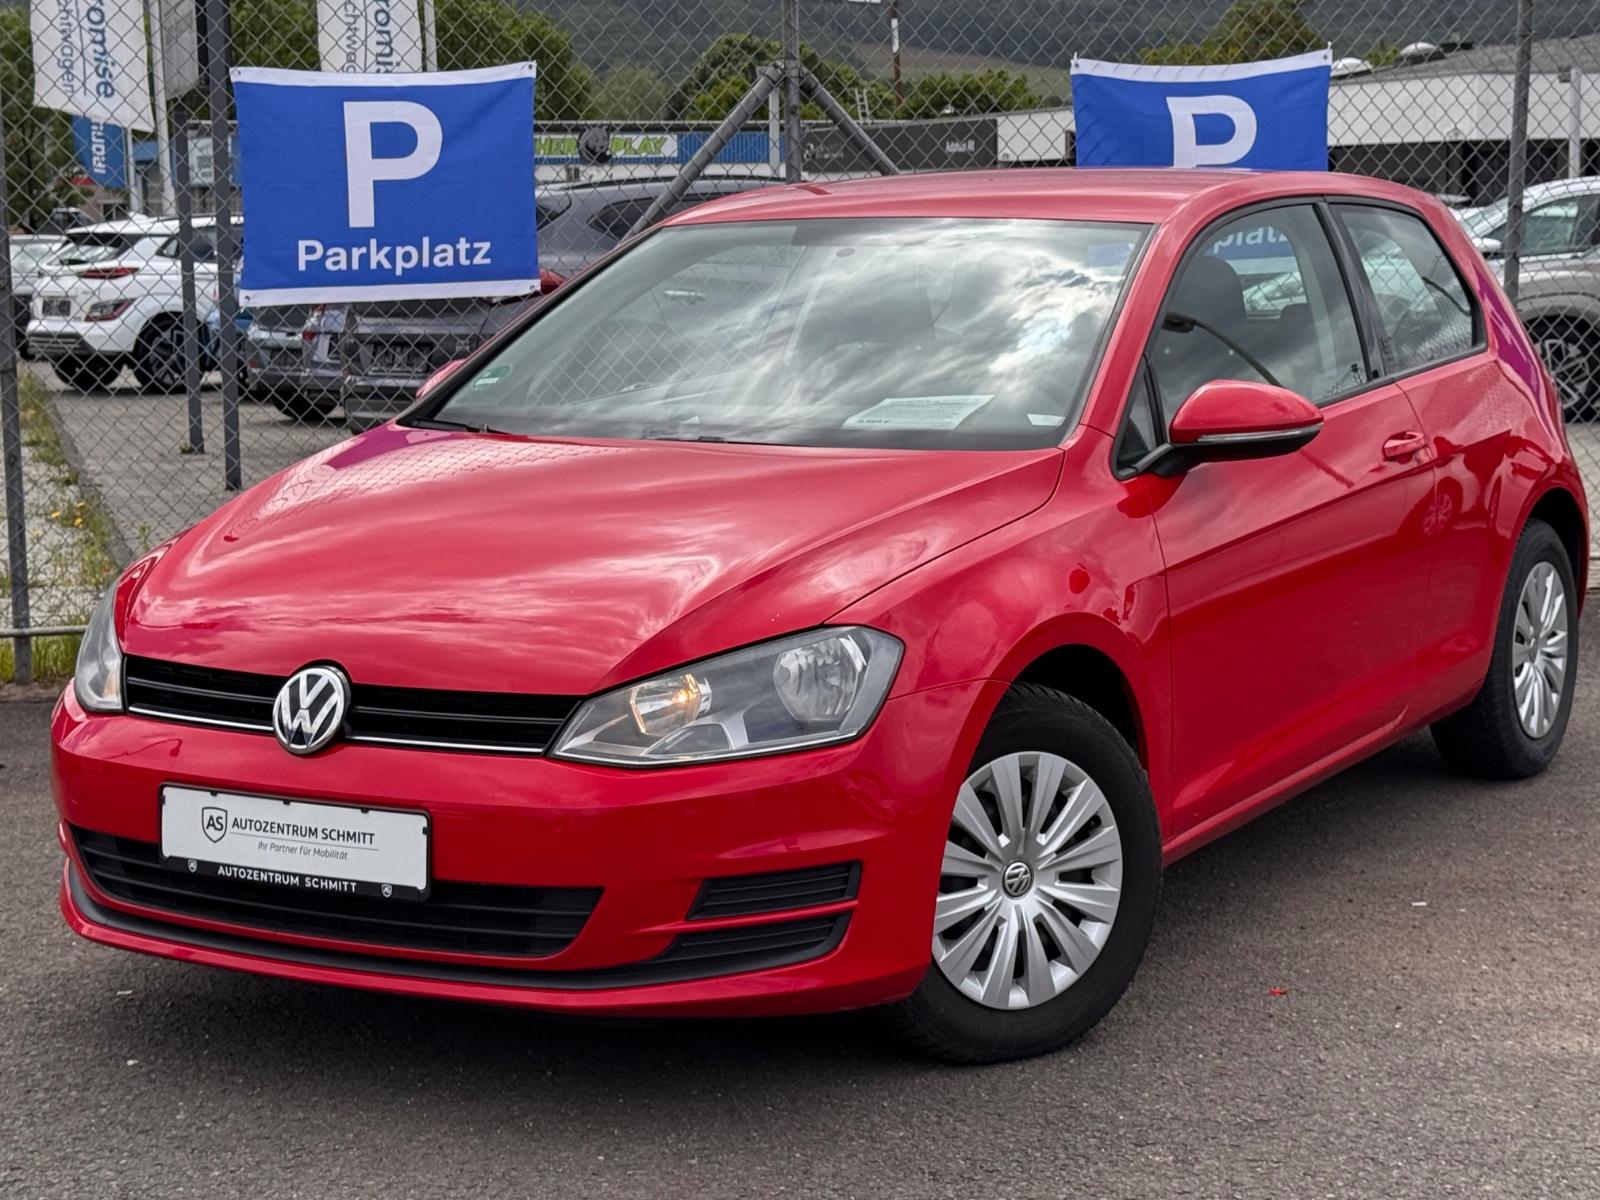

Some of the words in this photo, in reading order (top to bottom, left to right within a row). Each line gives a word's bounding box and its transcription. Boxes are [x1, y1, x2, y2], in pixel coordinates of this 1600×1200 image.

[86, 0, 116, 98] omise
[611, 137, 667, 155] PLAY
[1165, 95, 1257, 168] P
[343, 101, 443, 228] P
[298, 237, 492, 275] Parkplatz
[206, 815, 224, 831] AS
[231, 817, 318, 839] AUTOZENTRUM
[321, 828, 375, 845] SCHMITT
[258, 841, 268, 850] Ihr
[269, 843, 298, 854] Partner
[299, 846, 311, 856] für
[313, 848, 348, 860] Mobilität
[218, 865, 299, 886] AUTOZENTRUM
[305, 877, 357, 893] SCHMITT
